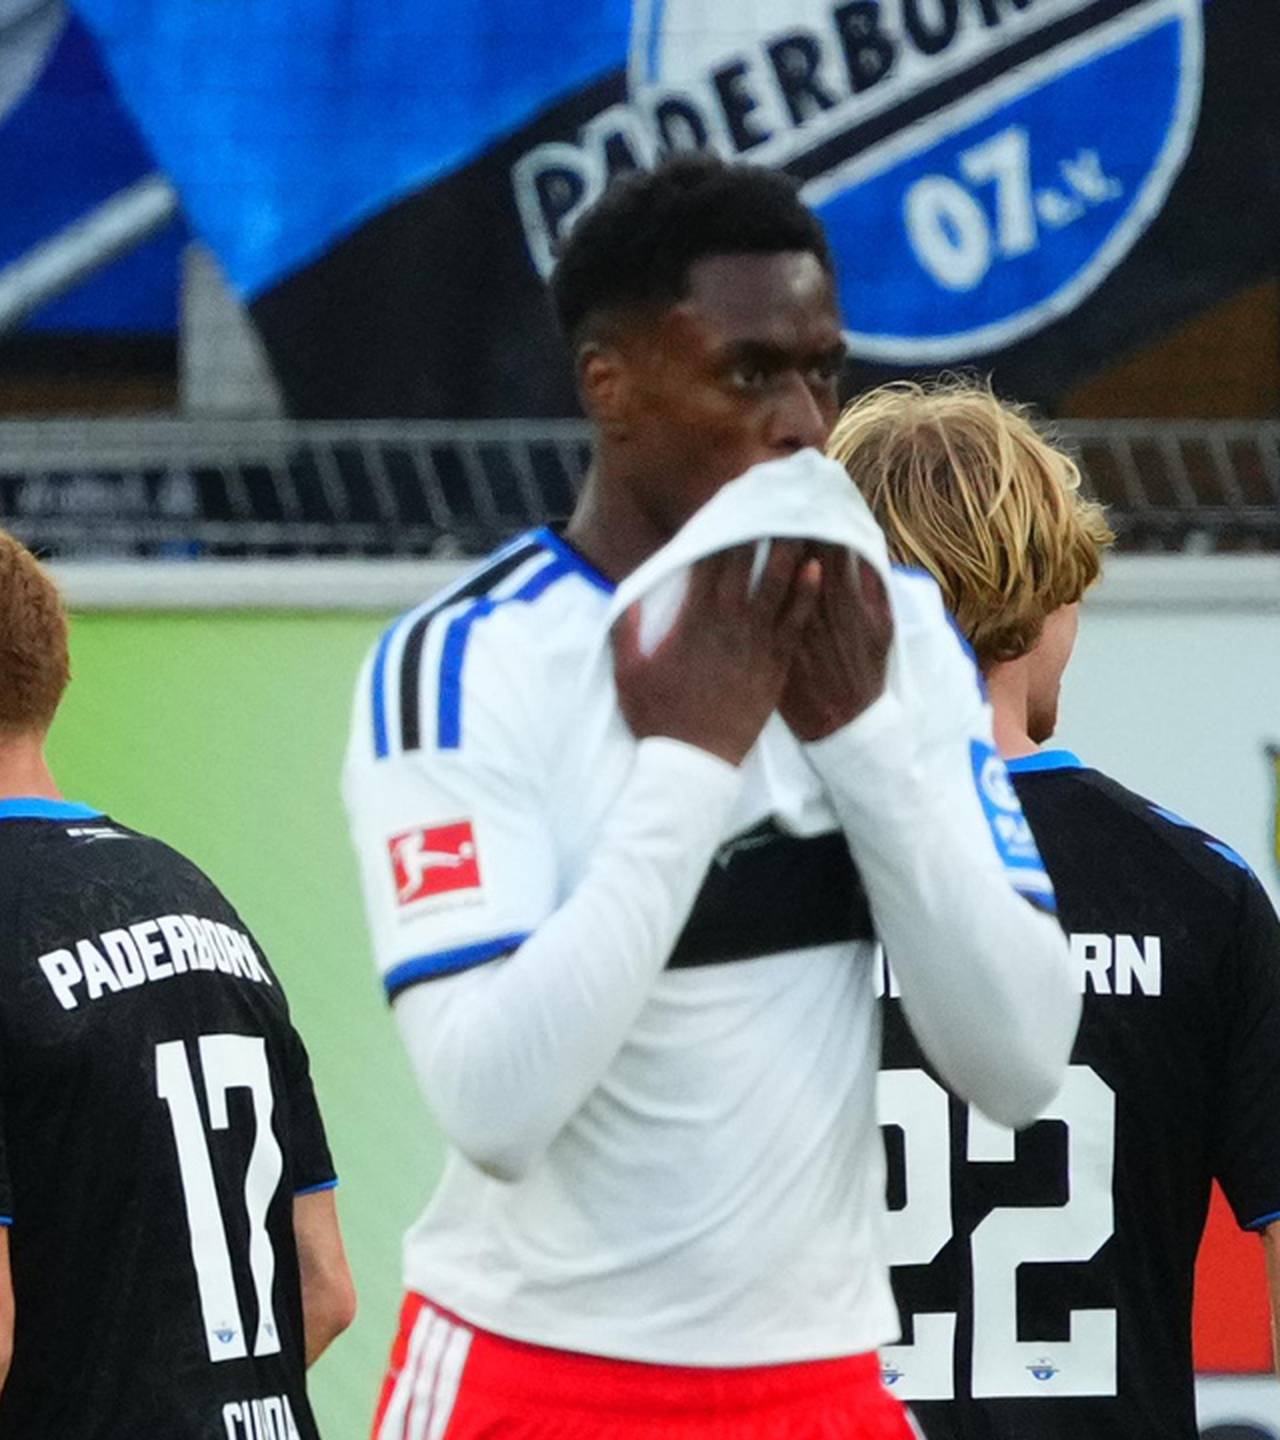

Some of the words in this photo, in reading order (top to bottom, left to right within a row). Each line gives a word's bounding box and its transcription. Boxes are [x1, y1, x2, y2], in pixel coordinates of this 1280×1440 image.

[904, 122, 1038, 292] 07
[154, 1033, 284, 1363] 17
[876, 1064, 1117, 1400] 22
